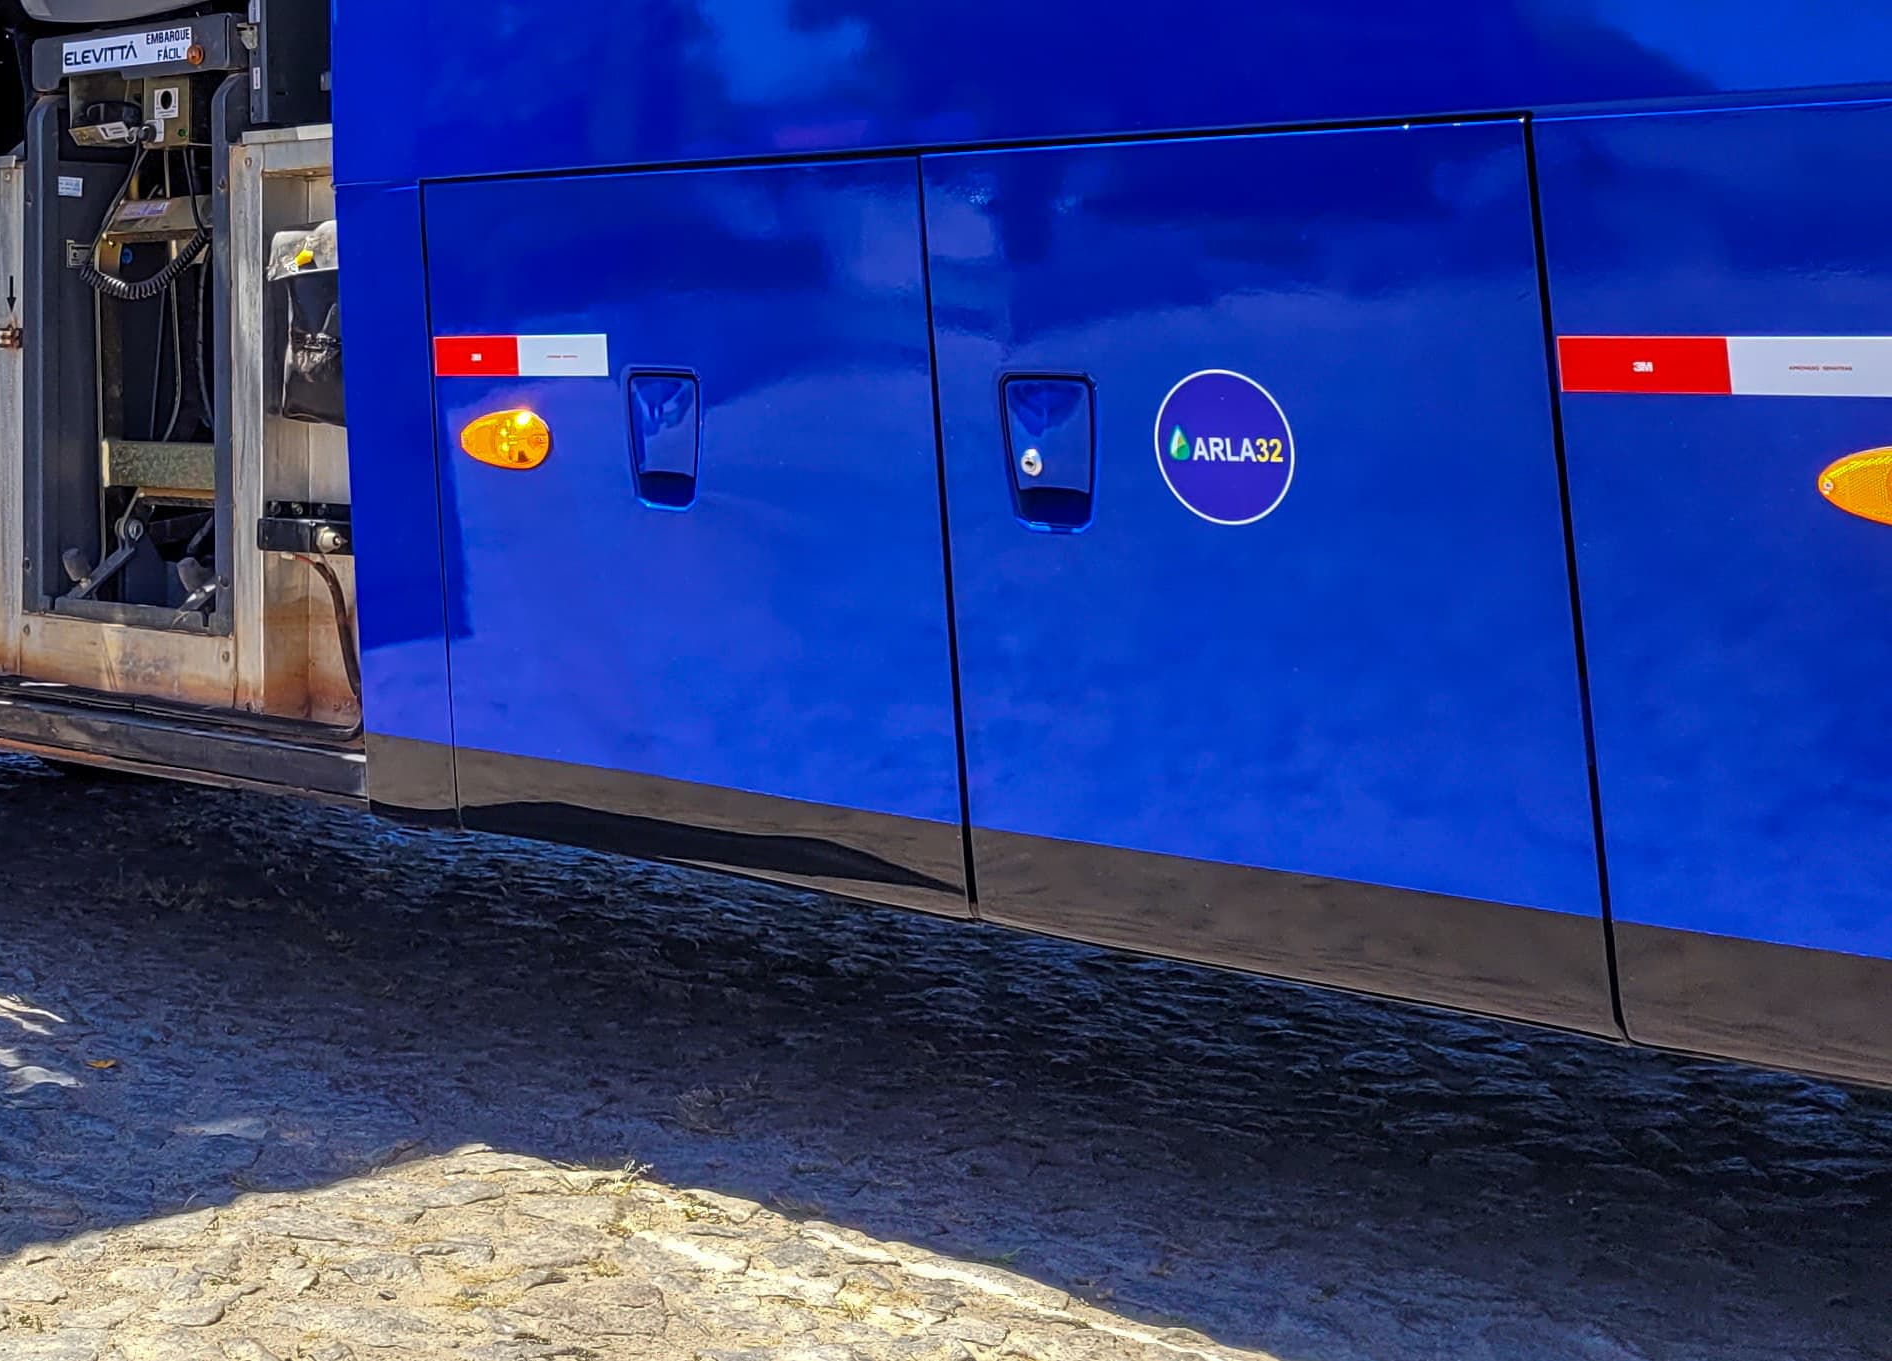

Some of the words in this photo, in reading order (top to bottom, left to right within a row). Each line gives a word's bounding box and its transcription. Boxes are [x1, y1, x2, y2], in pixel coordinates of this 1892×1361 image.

[146, 28, 190, 45] EMBARQUE
[1633, 361, 1654, 372] 3M
[1193, 437, 1284, 463] ARLA32
